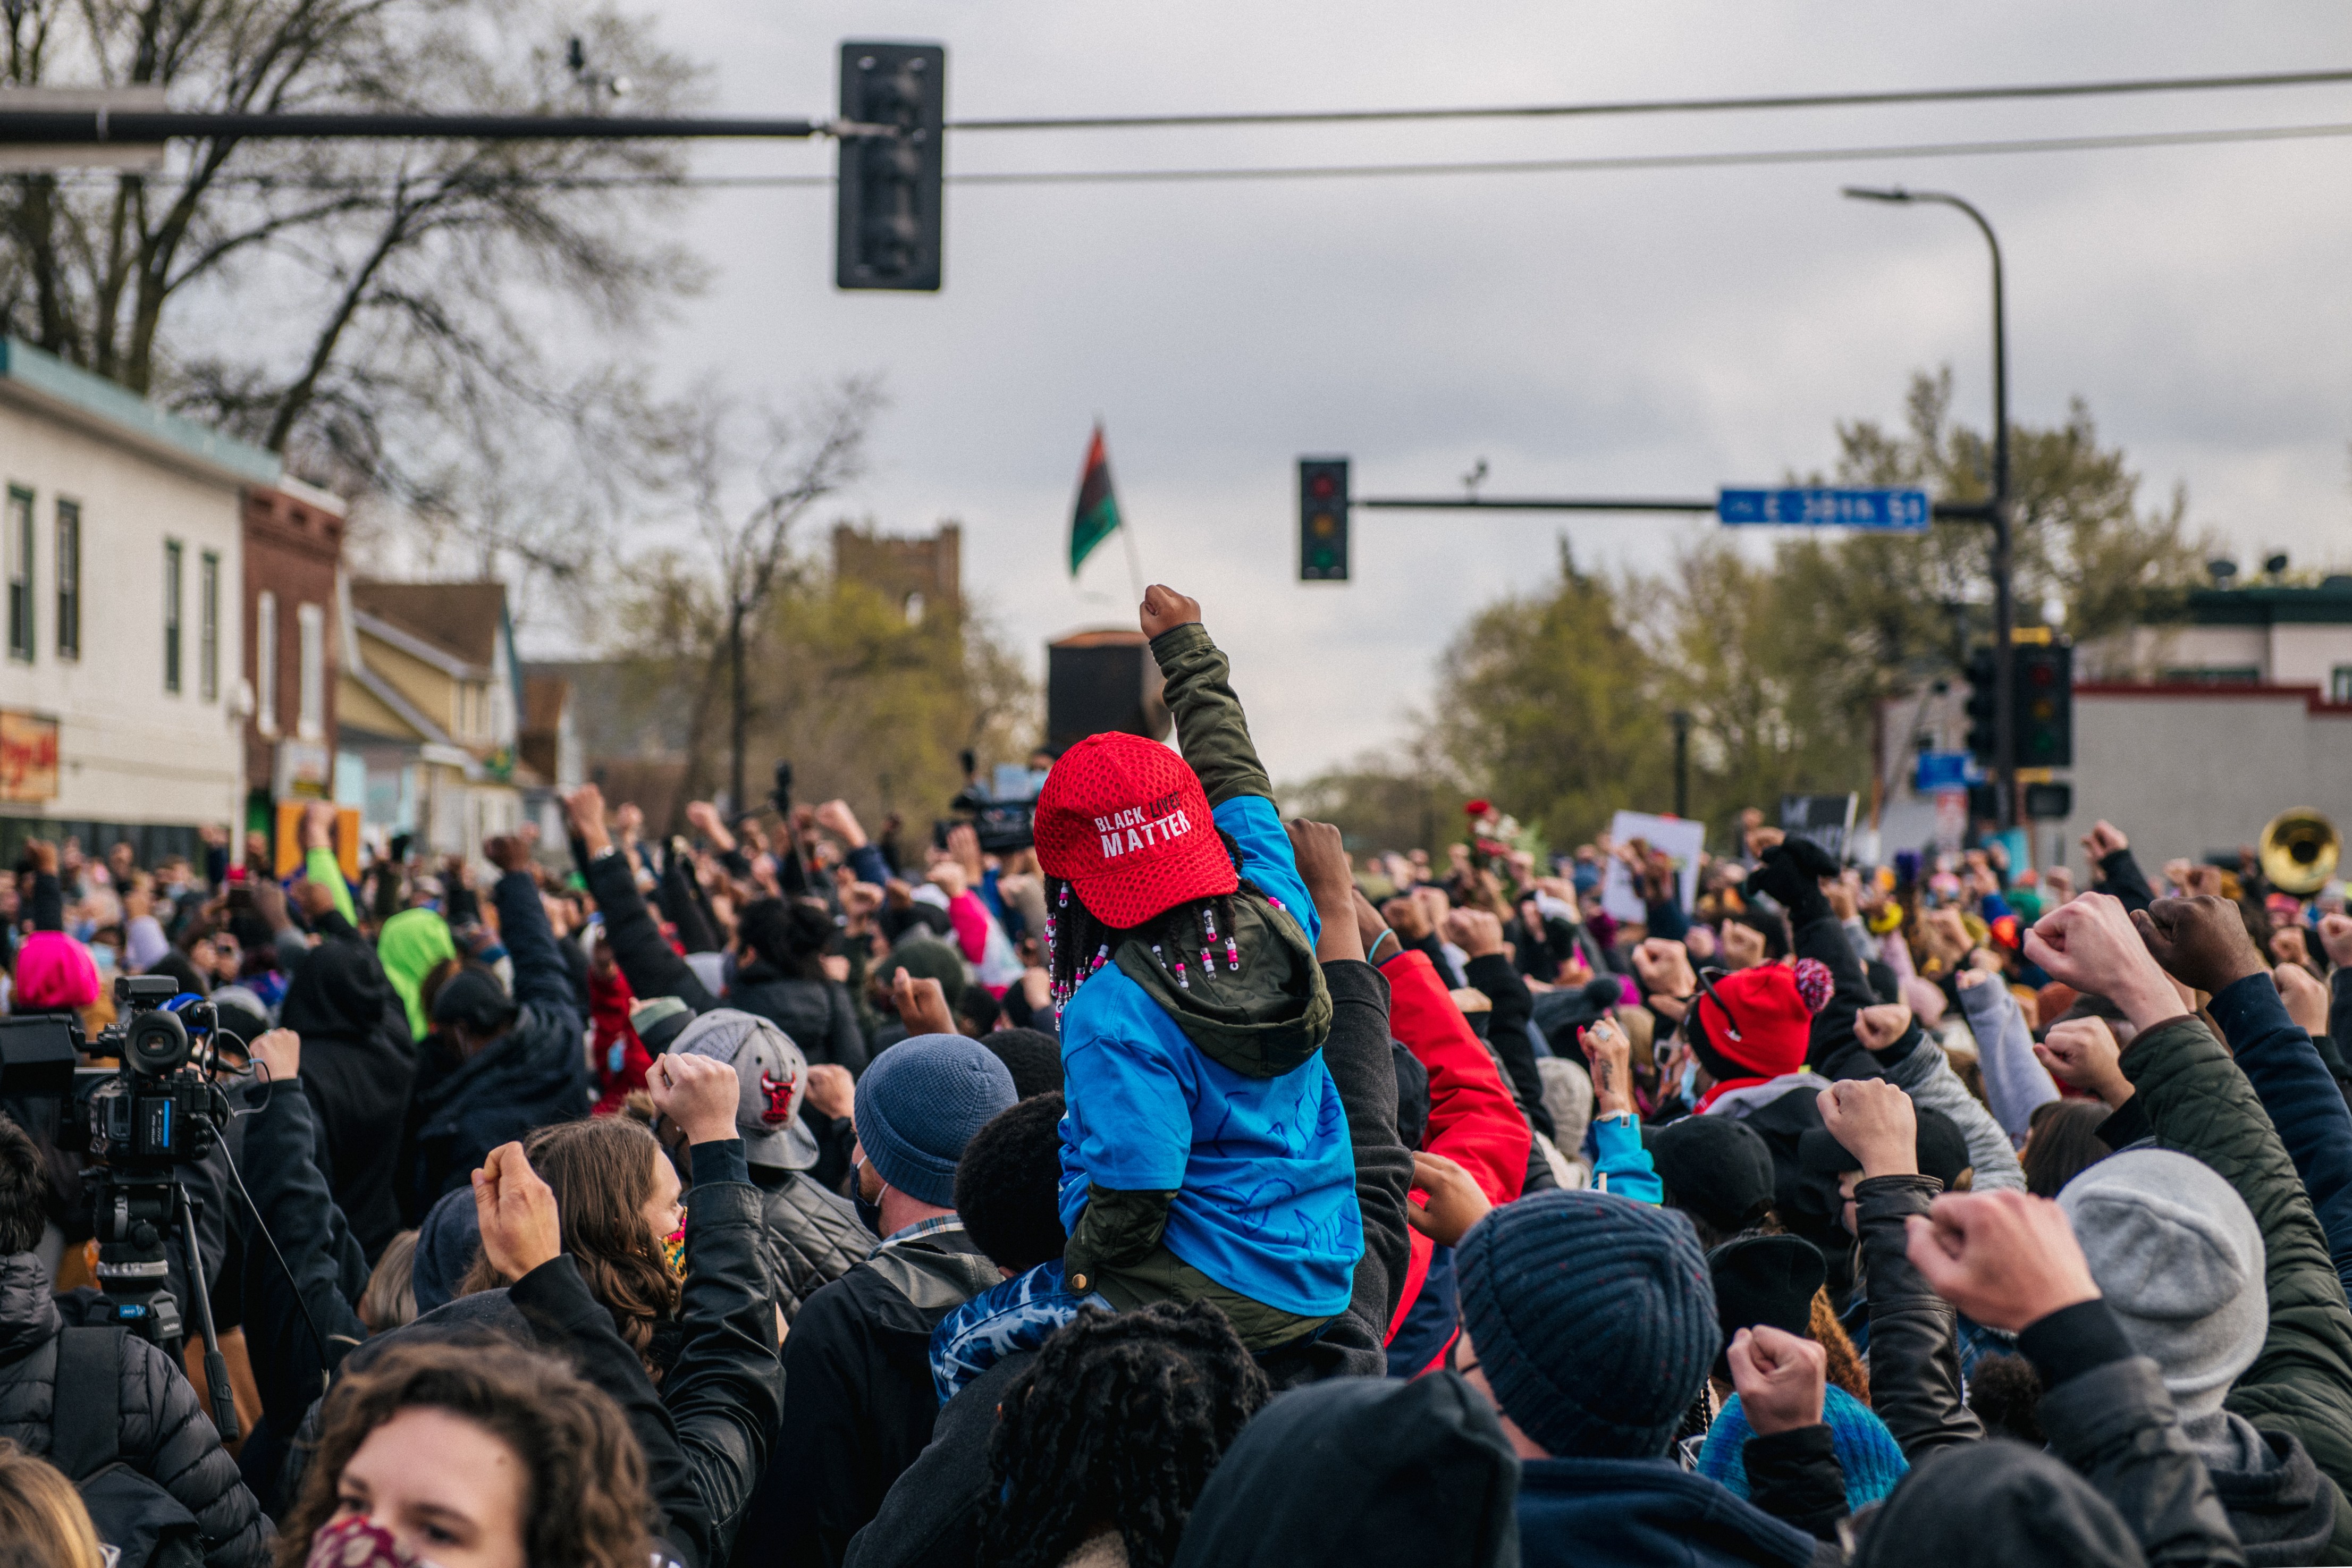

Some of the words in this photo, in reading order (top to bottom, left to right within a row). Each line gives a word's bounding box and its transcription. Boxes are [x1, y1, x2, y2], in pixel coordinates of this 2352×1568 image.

[1094, 806, 1147, 832] BLACK
[1149, 791, 1181, 818] LIVES
[1101, 810, 1191, 858] MATTER
